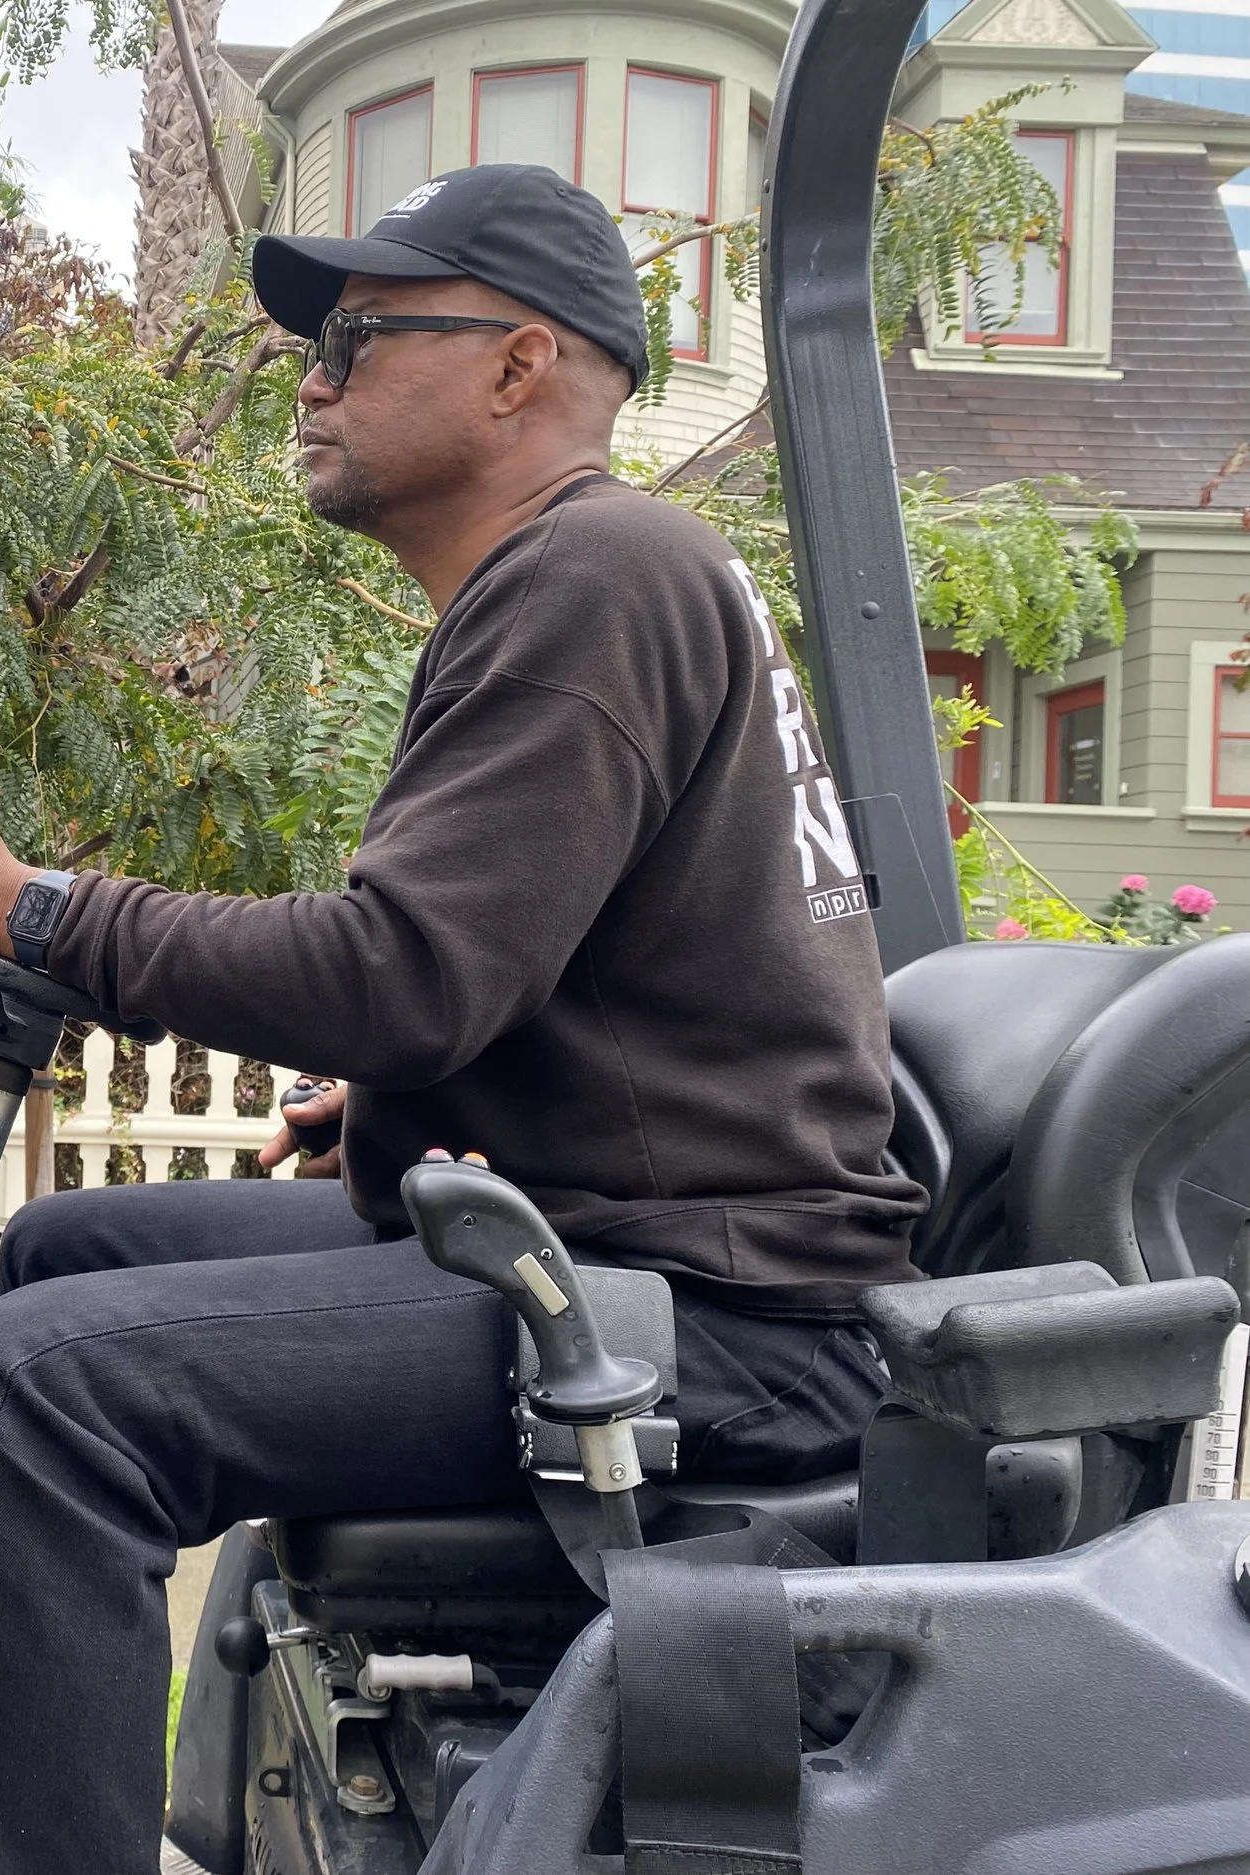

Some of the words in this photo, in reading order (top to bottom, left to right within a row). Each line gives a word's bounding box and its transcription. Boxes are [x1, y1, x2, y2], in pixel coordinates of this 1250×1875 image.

[812, 888, 865, 919] npr
[1207, 1432, 1221, 1444] 70
[1205, 1449, 1219, 1462] 80
[1203, 1467, 1217, 1479] 90
[1196, 1484, 1216, 1497] 100
